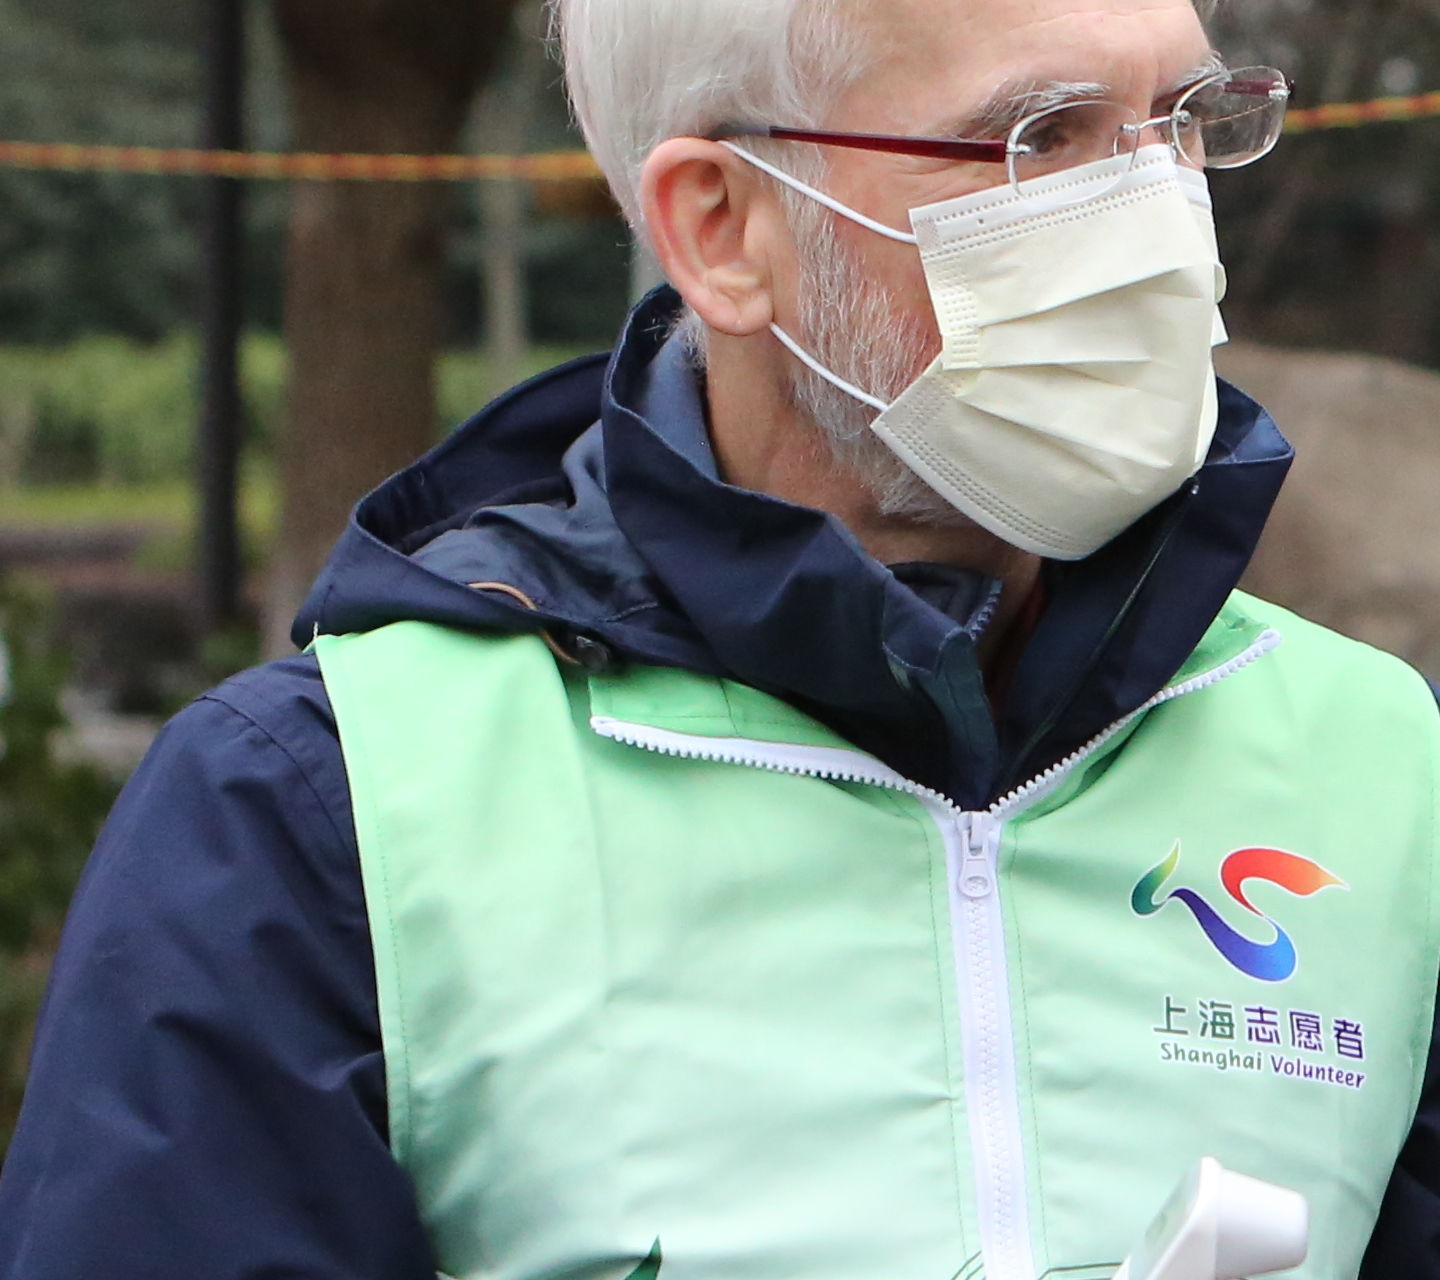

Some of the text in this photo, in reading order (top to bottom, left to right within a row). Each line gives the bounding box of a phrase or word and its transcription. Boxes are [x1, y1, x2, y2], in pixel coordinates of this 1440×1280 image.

[1153, 996, 1364, 1060] 上海志愿者
[1160, 1042, 1365, 1088] Shanghai Volunteer
